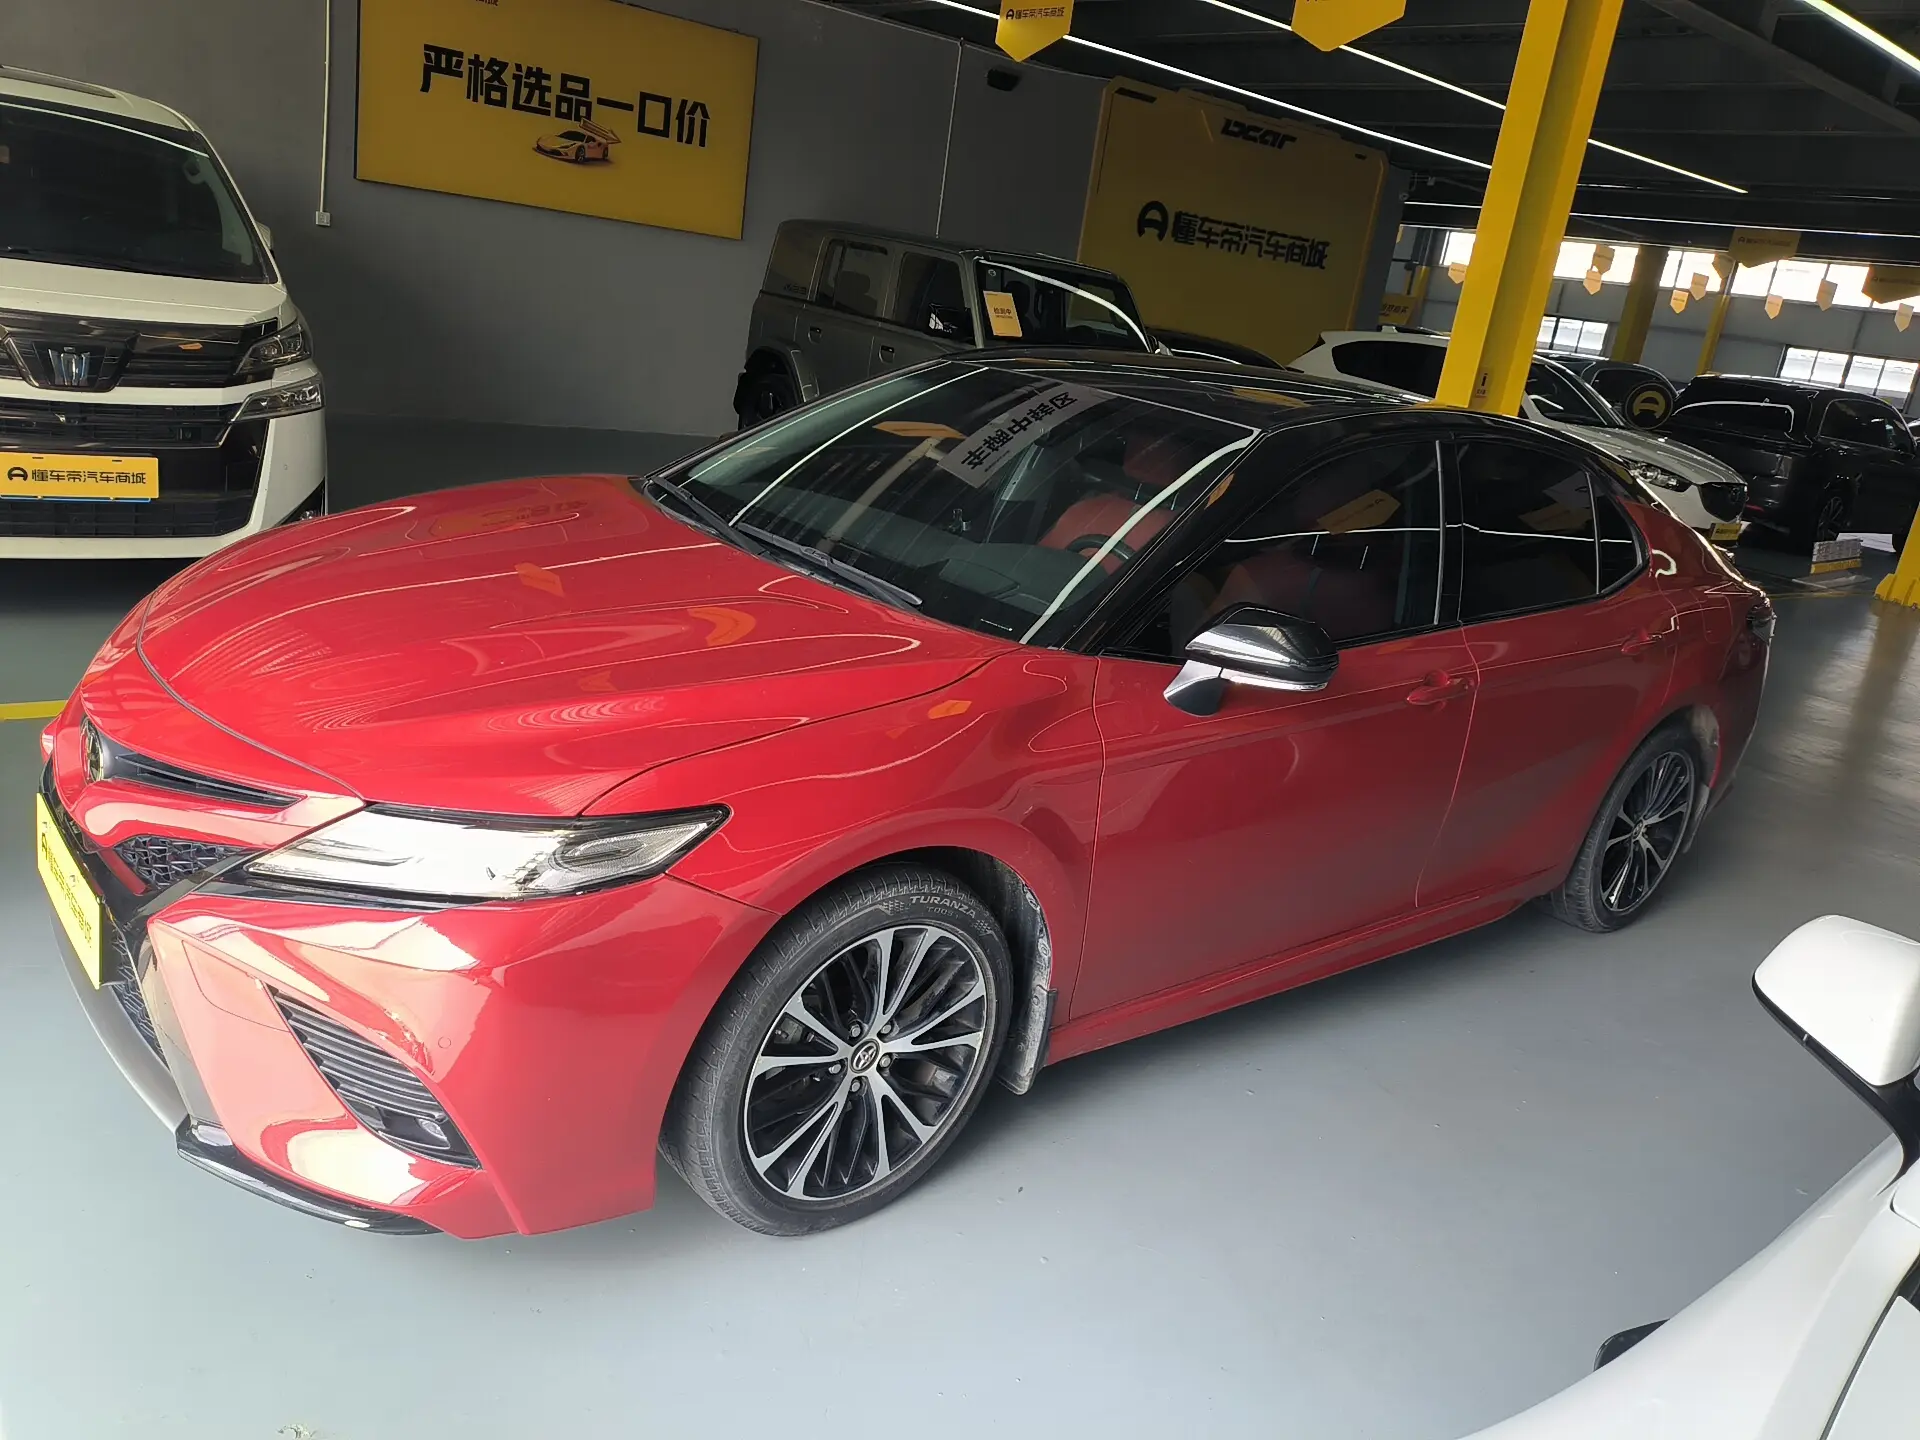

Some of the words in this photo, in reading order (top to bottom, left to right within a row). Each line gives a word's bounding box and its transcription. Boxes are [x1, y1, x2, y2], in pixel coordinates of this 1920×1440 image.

[420, 43, 711, 148] 严格选品一口价
[1171, 210, 1331, 270] 懂车帝汽车商城
[31, 468, 147, 485] 懂车帝汽车商城
[909, 895, 977, 919] TURANZA
